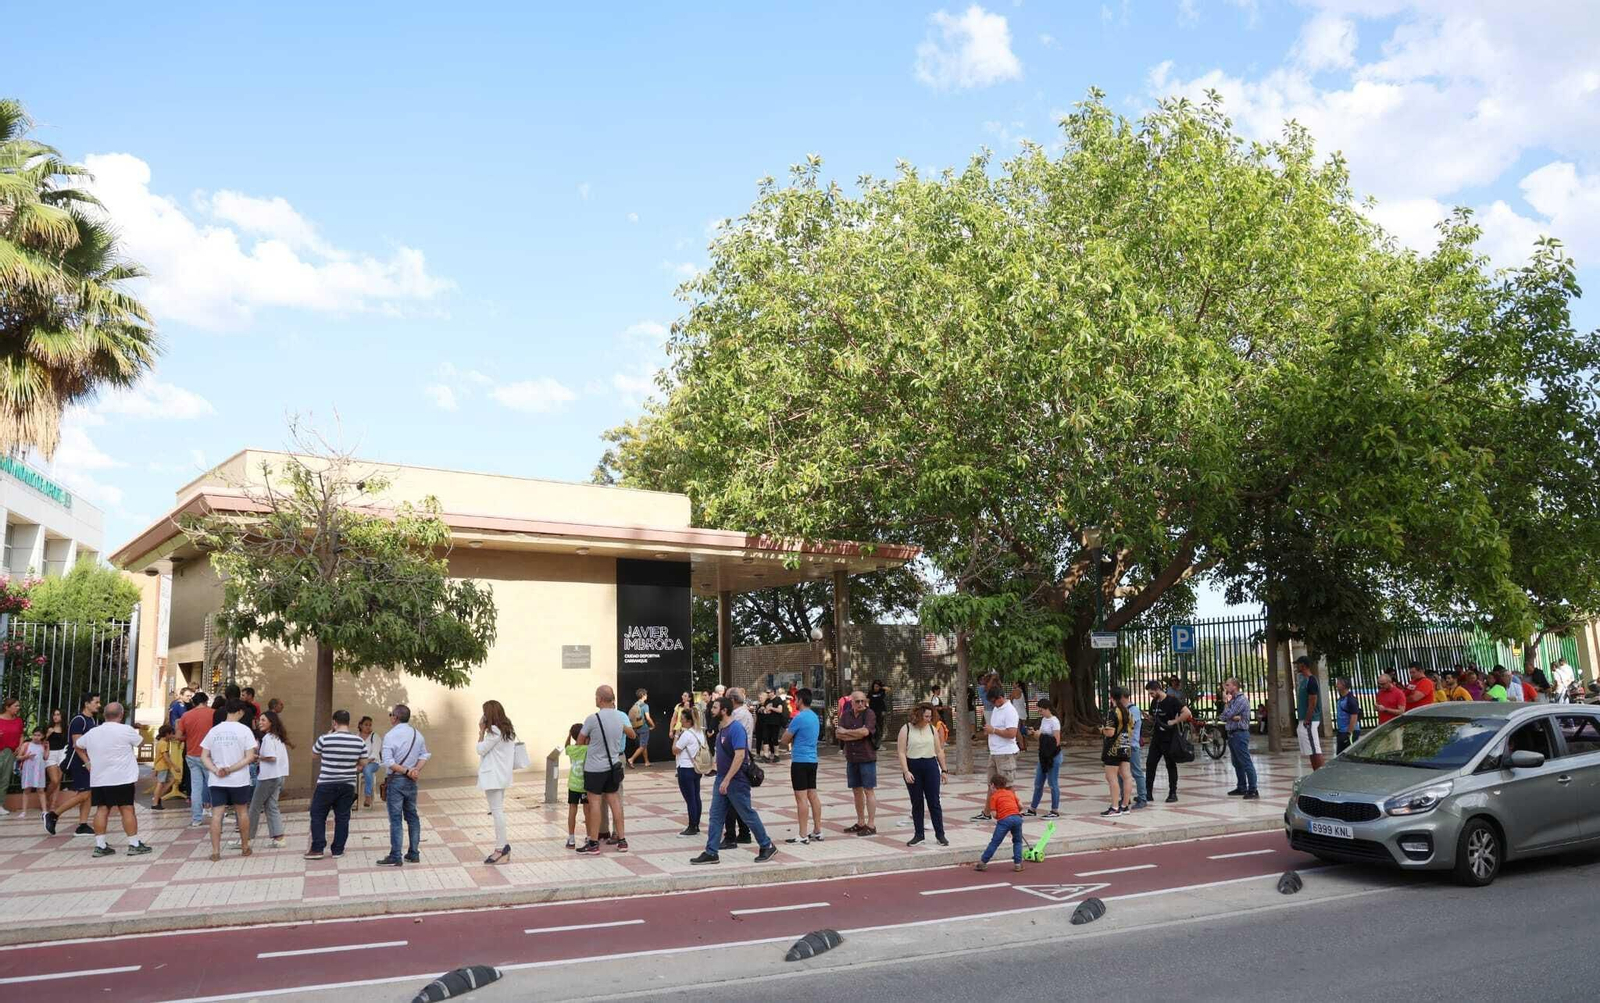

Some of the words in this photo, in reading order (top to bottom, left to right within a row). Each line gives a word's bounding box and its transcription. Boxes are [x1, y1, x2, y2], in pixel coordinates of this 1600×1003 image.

[624, 625, 669, 638] JAVIER
[624, 638, 684, 650] IMBRODA
[1177, 629, 1189, 649] P
[1312, 822, 1332, 834] 6999
[1334, 826, 1350, 838] KNL
